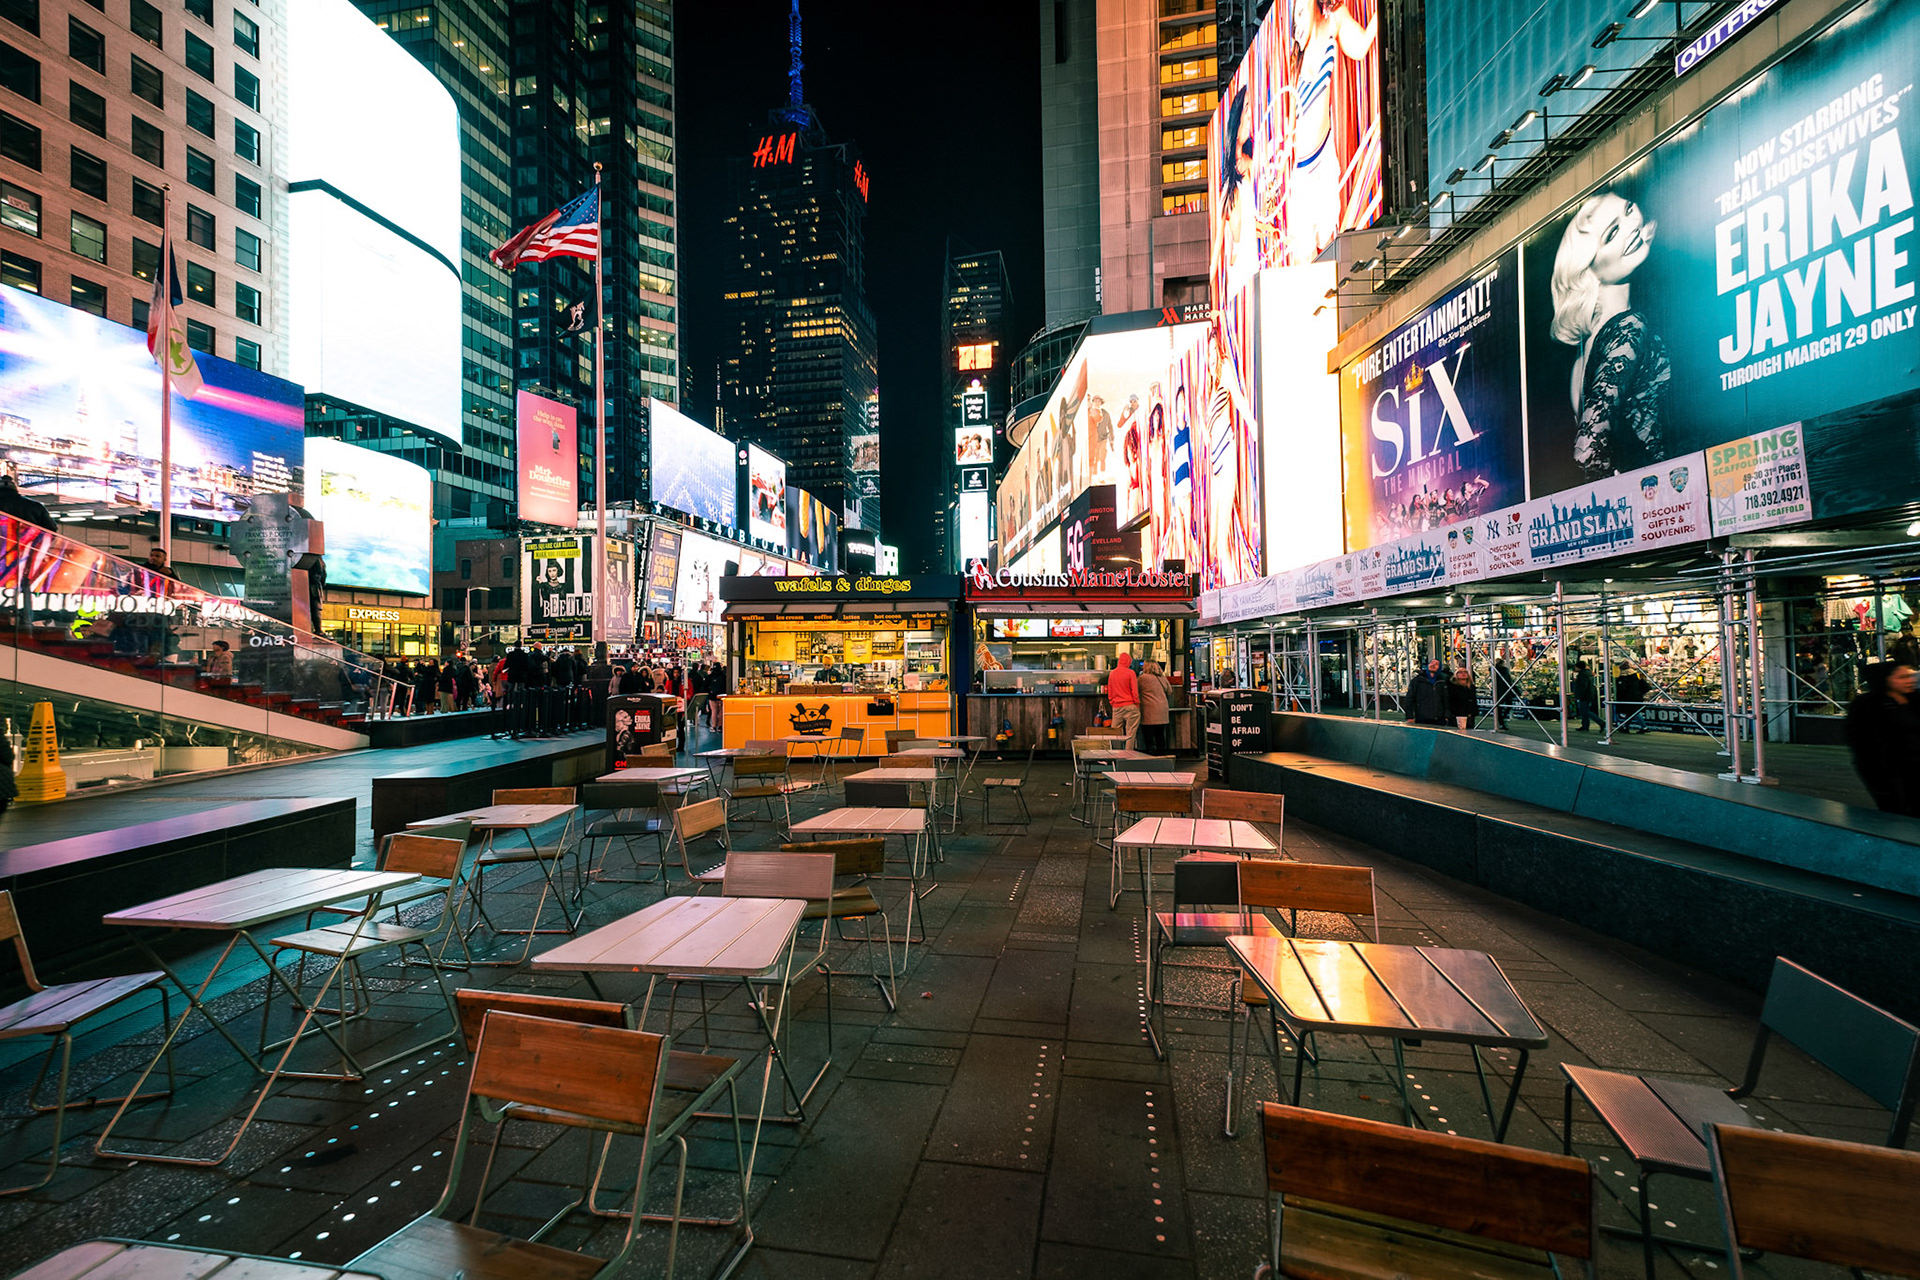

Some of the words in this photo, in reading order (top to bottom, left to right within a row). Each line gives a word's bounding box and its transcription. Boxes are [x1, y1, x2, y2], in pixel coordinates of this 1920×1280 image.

[1734, 136, 1776, 183] NOW
[1779, 73, 1883, 155] STARRING
[753, 132, 797, 168] H&M
[854, 160, 869, 203] H&M
[1715, 127, 1914, 296] ERIKA
[1719, 216, 1915, 365] JAYNE
[1438, 337, 1448, 348] The
[1448, 331, 1459, 342] New
[1460, 323, 1473, 337] York
[1472, 311, 1491, 326] Times
[1719, 354, 1782, 391] THROUGH
[1784, 332, 1842, 370] MARCH
[1844, 324, 1868, 350] 29
[1870, 305, 1917, 340] ONLY
[1371, 342, 1480, 479] SIX
[1712, 430, 1797, 467] SPRING
[1713, 453, 1779, 476] SCAFFOLDING
[1782, 447, 1799, 458] LLC
[529, 469, 571, 488] Doubtfire
[1383, 473, 1402, 497] THE
[1408, 451, 1462, 488] MUSICAL
[1743, 470, 1763, 482] 49-30
[1778, 462, 1800, 474] Place
[1761, 477, 1775, 487] NY
[1776, 471, 1802, 484] 11101
[1744, 485, 1804, 510] 718.392.4921
[1642, 502, 1692, 520] DISCOUNT
[1718, 516, 1737, 527] HOIST
[1743, 512, 1760, 522] SHED
[1766, 503, 1804, 518] SCAFFOLD
[1507, 523, 1523, 536] NY
[1528, 517, 1584, 549] GRAND
[1583, 505, 1633, 536] SLAM
[1648, 516, 1676, 530] GIFTS
[1677, 515, 1684, 524] &
[1640, 524, 1696, 542] SOUVENIRS
[738, 528, 815, 565] BROADWAY
[1067, 520, 1084, 576] 5G
[1489, 541, 1520, 554] DISCOUNT
[654, 554, 676, 568] COME
[1385, 561, 1416, 579] GRAND
[1416, 552, 1445, 573] SLAM
[652, 575, 674, 588] AWAY
[774, 577, 832, 592] wafels
[835, 580, 851, 592] &
[855, 577, 912, 594] dinges
[996, 567, 1069, 588] Cousins
[349, 608, 400, 621] EXPRESS
[1222, 610, 1241, 620] OFFICIAL
[1242, 603, 1276, 617] MERCHANDISE
[1230, 704, 1253, 712] DON'T
[1658, 709, 1698, 723] OPEN
[635, 715, 651, 723] ERIKA
[635, 722, 651, 730] JAYNE
[1231, 716, 1241, 724] BE
[1232, 726, 1261, 735] AFRAID
[1232, 739, 1242, 747] OF
